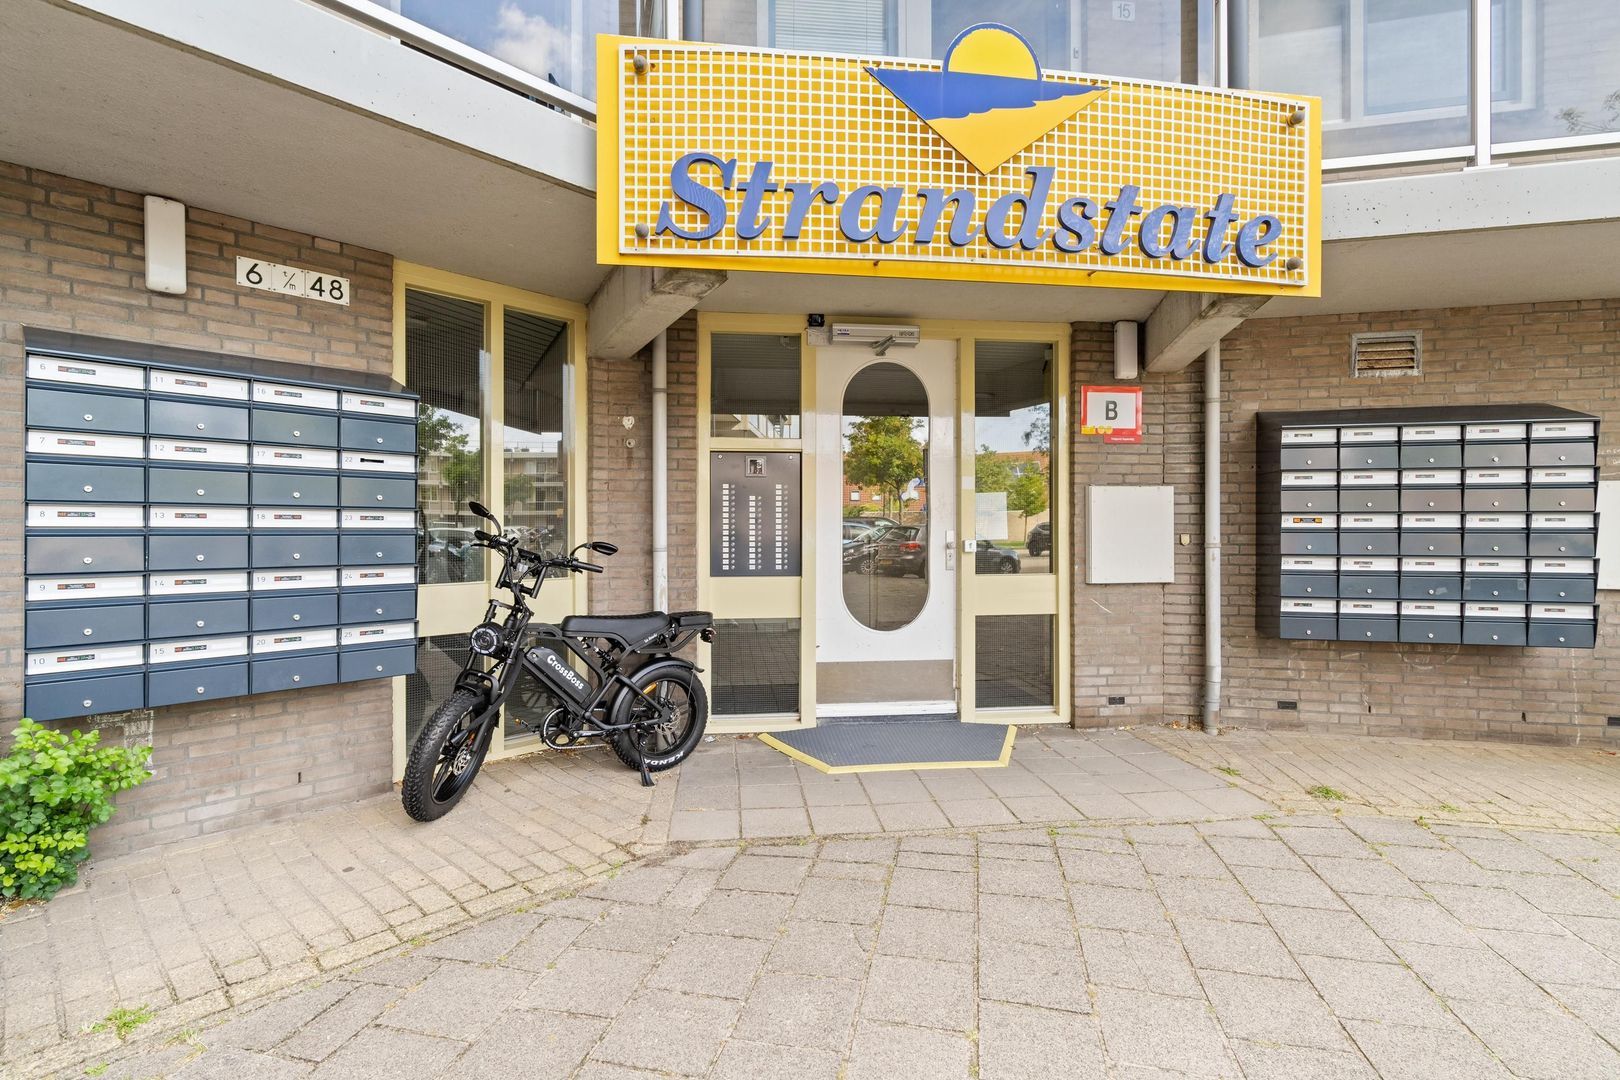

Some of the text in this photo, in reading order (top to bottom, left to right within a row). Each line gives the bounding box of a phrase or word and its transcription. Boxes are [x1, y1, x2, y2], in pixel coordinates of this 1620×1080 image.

[1118, 3, 1130, 18] 15
[654, 151, 1283, 268] Strandstate
[246, 263, 262, 285] 6
[310, 276, 344, 300] 48
[1106, 400, 1118, 420] B
[547, 654, 584, 690] CrossBoss
[644, 750, 684, 766] KENDA
